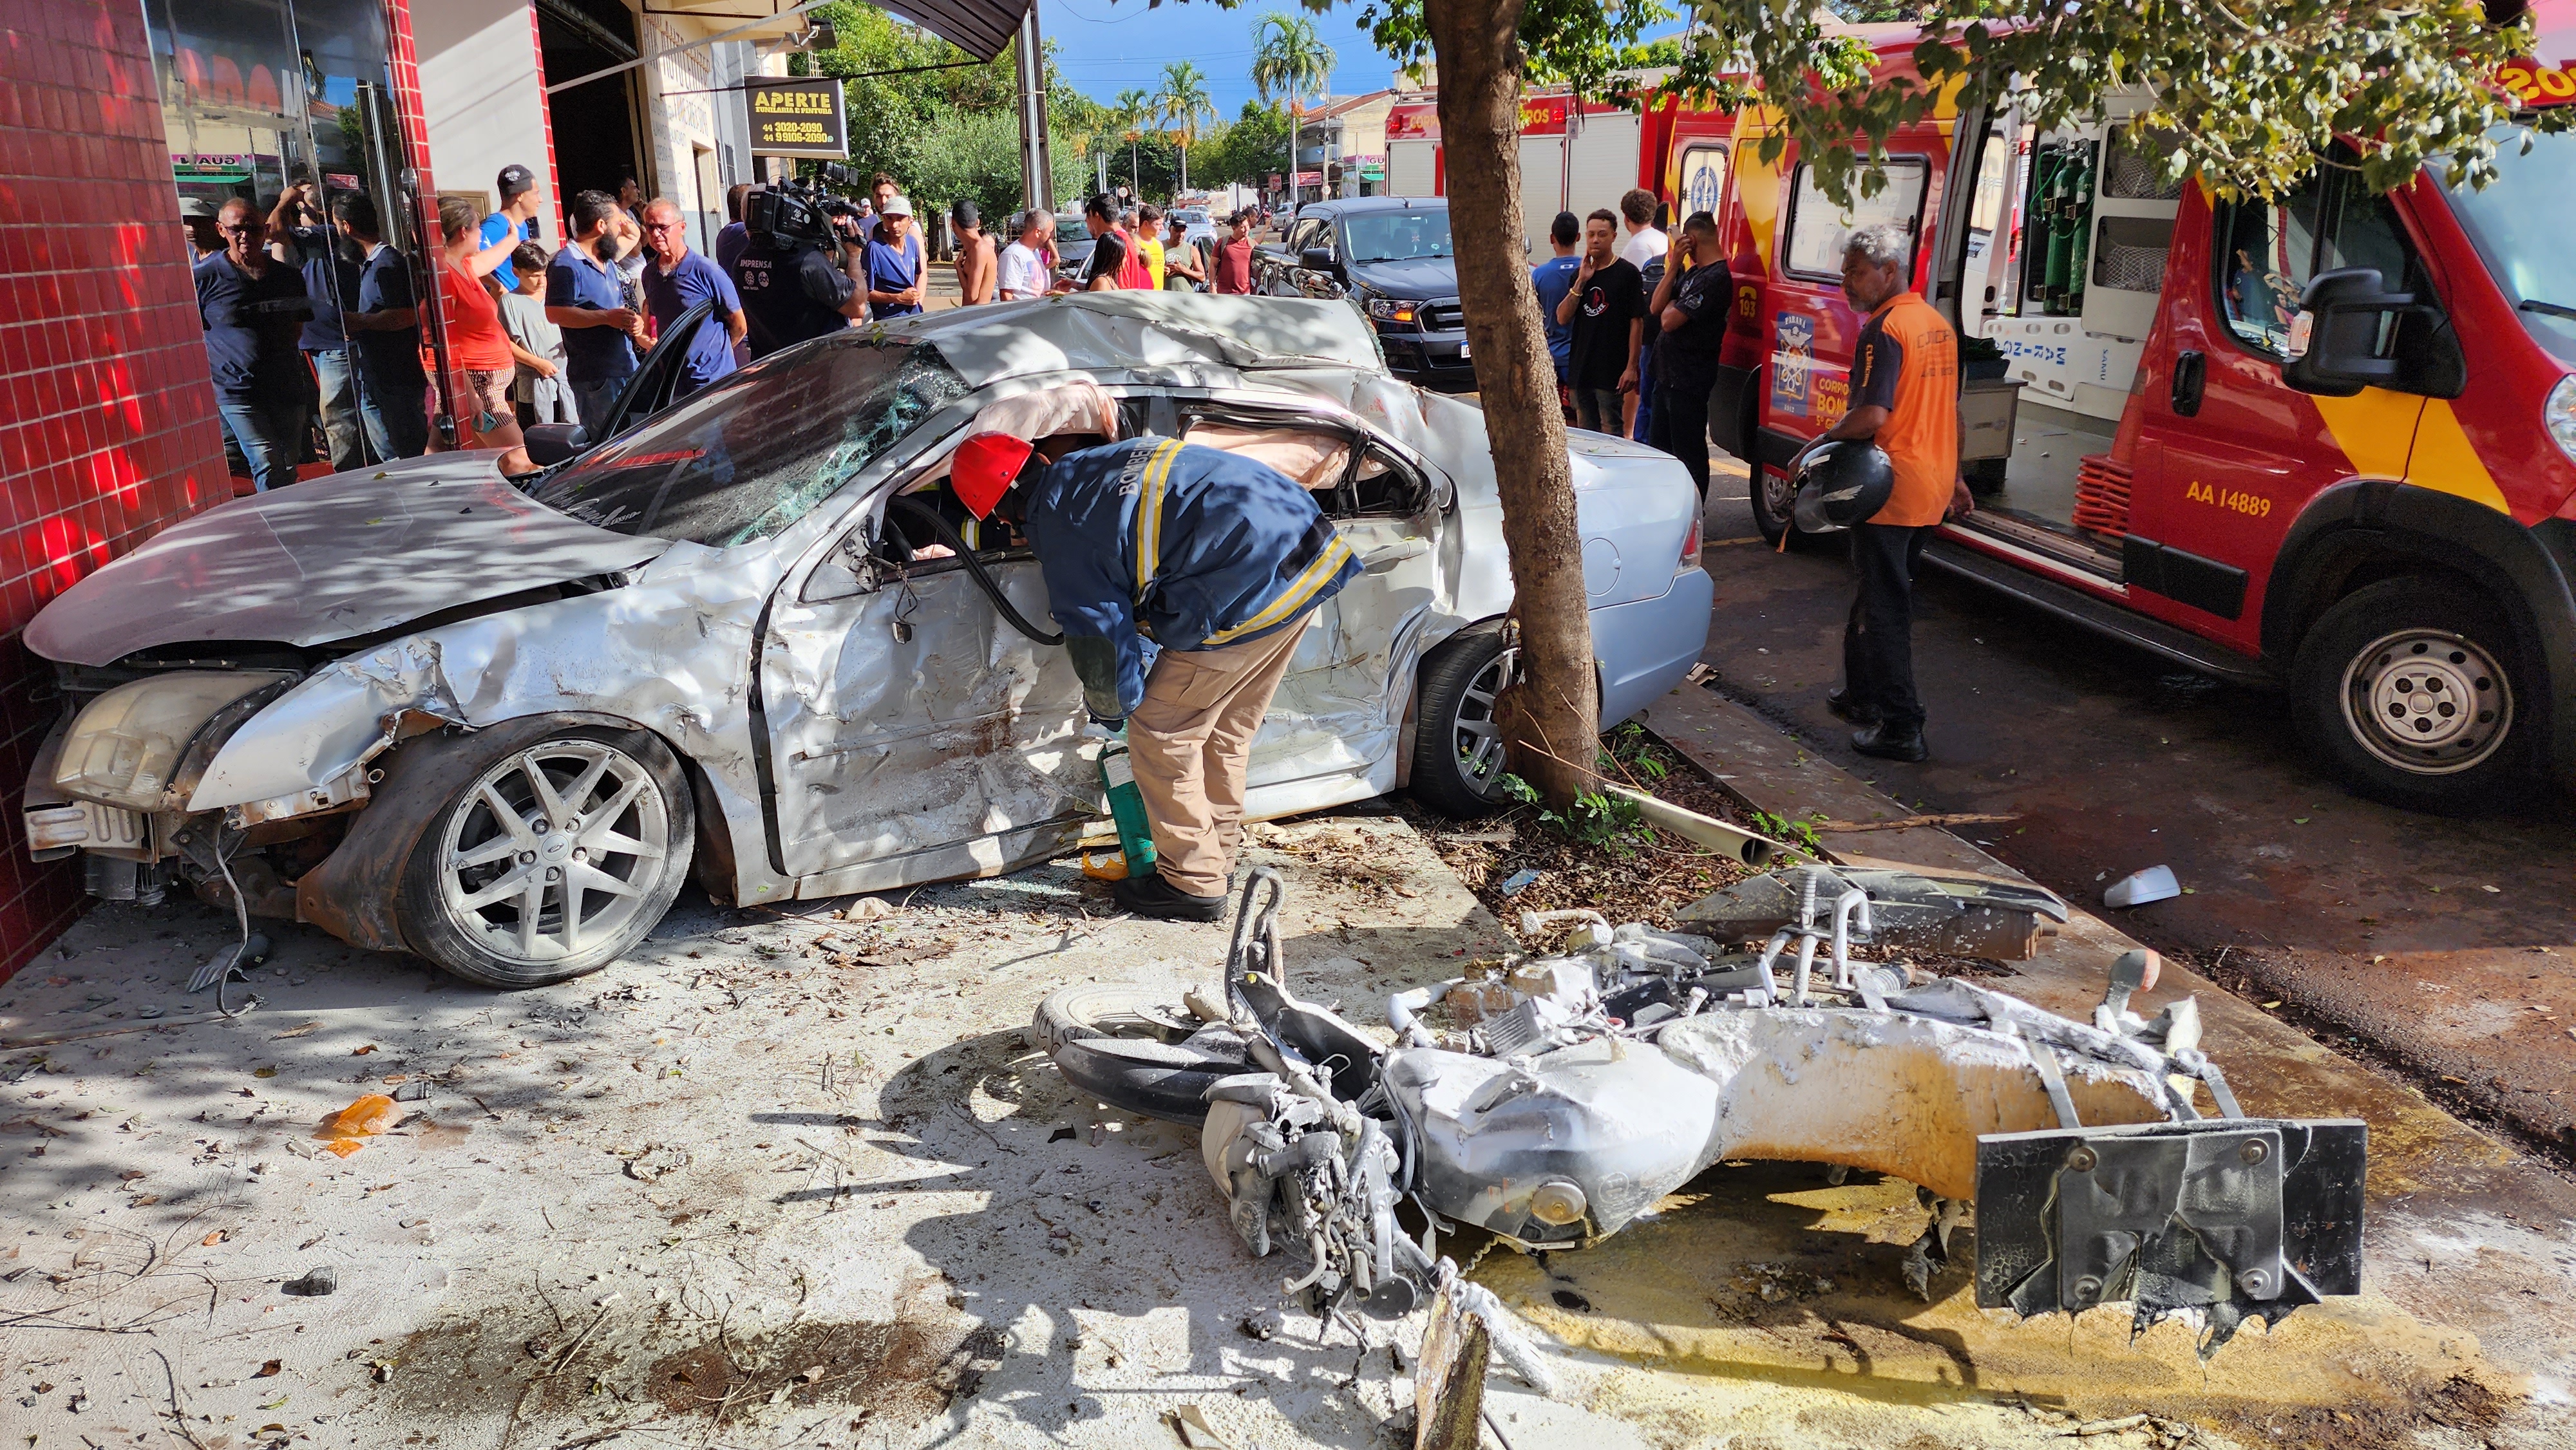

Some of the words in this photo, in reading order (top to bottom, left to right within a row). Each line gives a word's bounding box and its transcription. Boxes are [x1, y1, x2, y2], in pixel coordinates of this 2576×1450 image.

[755, 91, 831, 108] APERTE
[1524, 108, 1549, 124] ROS
[762, 124, 773, 132] 44
[775, 122, 823, 133] 3020-2090
[740, 259, 772, 269] IMPRENSA
[1584, 303, 1607, 314] MONCLER
[1740, 299, 1756, 317] 193
[2099, 348, 2109, 381] SAMU
[2186, 481, 2214, 505] AA
[2220, 488, 2271, 518] 14889
